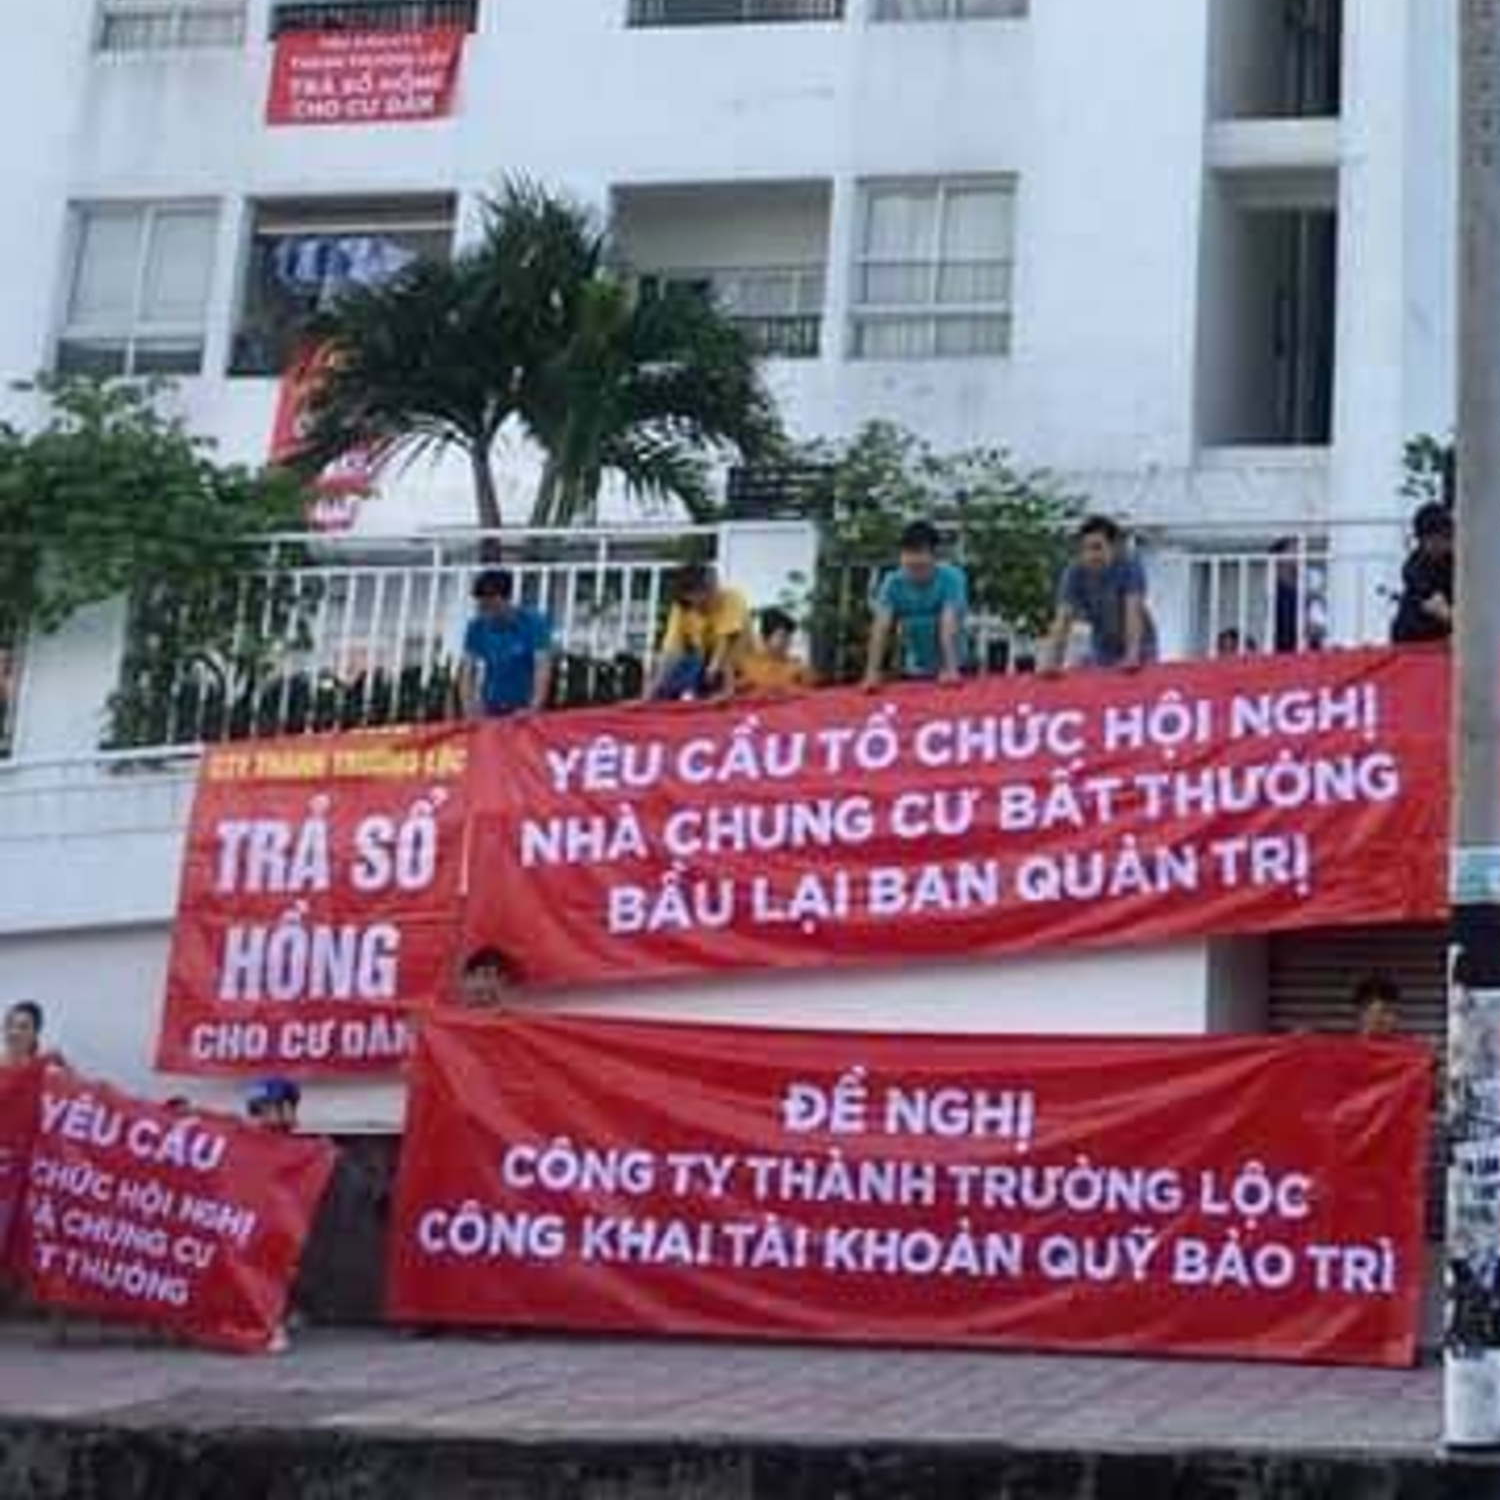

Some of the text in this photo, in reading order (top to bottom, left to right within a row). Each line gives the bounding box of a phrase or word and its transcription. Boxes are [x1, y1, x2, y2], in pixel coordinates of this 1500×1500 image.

[547, 682, 1378, 793] YÊU CẦU TỔ CHỨC HỘI NGHỊ
[215, 785, 448, 893] TRẢ SỔ
[521, 749, 1400, 868] NHÀ CHUNG CƯ BẤT THƯỜNG
[607, 832, 1310, 935] BẦU LẠI BAN QUẢN TRỊ
[219, 899, 401, 1001] HỒNG
[191, 1022, 269, 1059] CHO
[280, 1018, 335, 1058] CƯ
[39, 1091, 227, 1171] YÊU CẦU
[781, 1065, 1035, 1155] ĐỀ NGHỊ
[503, 1136, 1315, 1231] CÔNG TY THÀNH TRƯỜNG LỘC
[418, 1199, 1397, 1294] CÔNG KHAI TÀI KHOẢN QUỸ BẢO TRÌ
